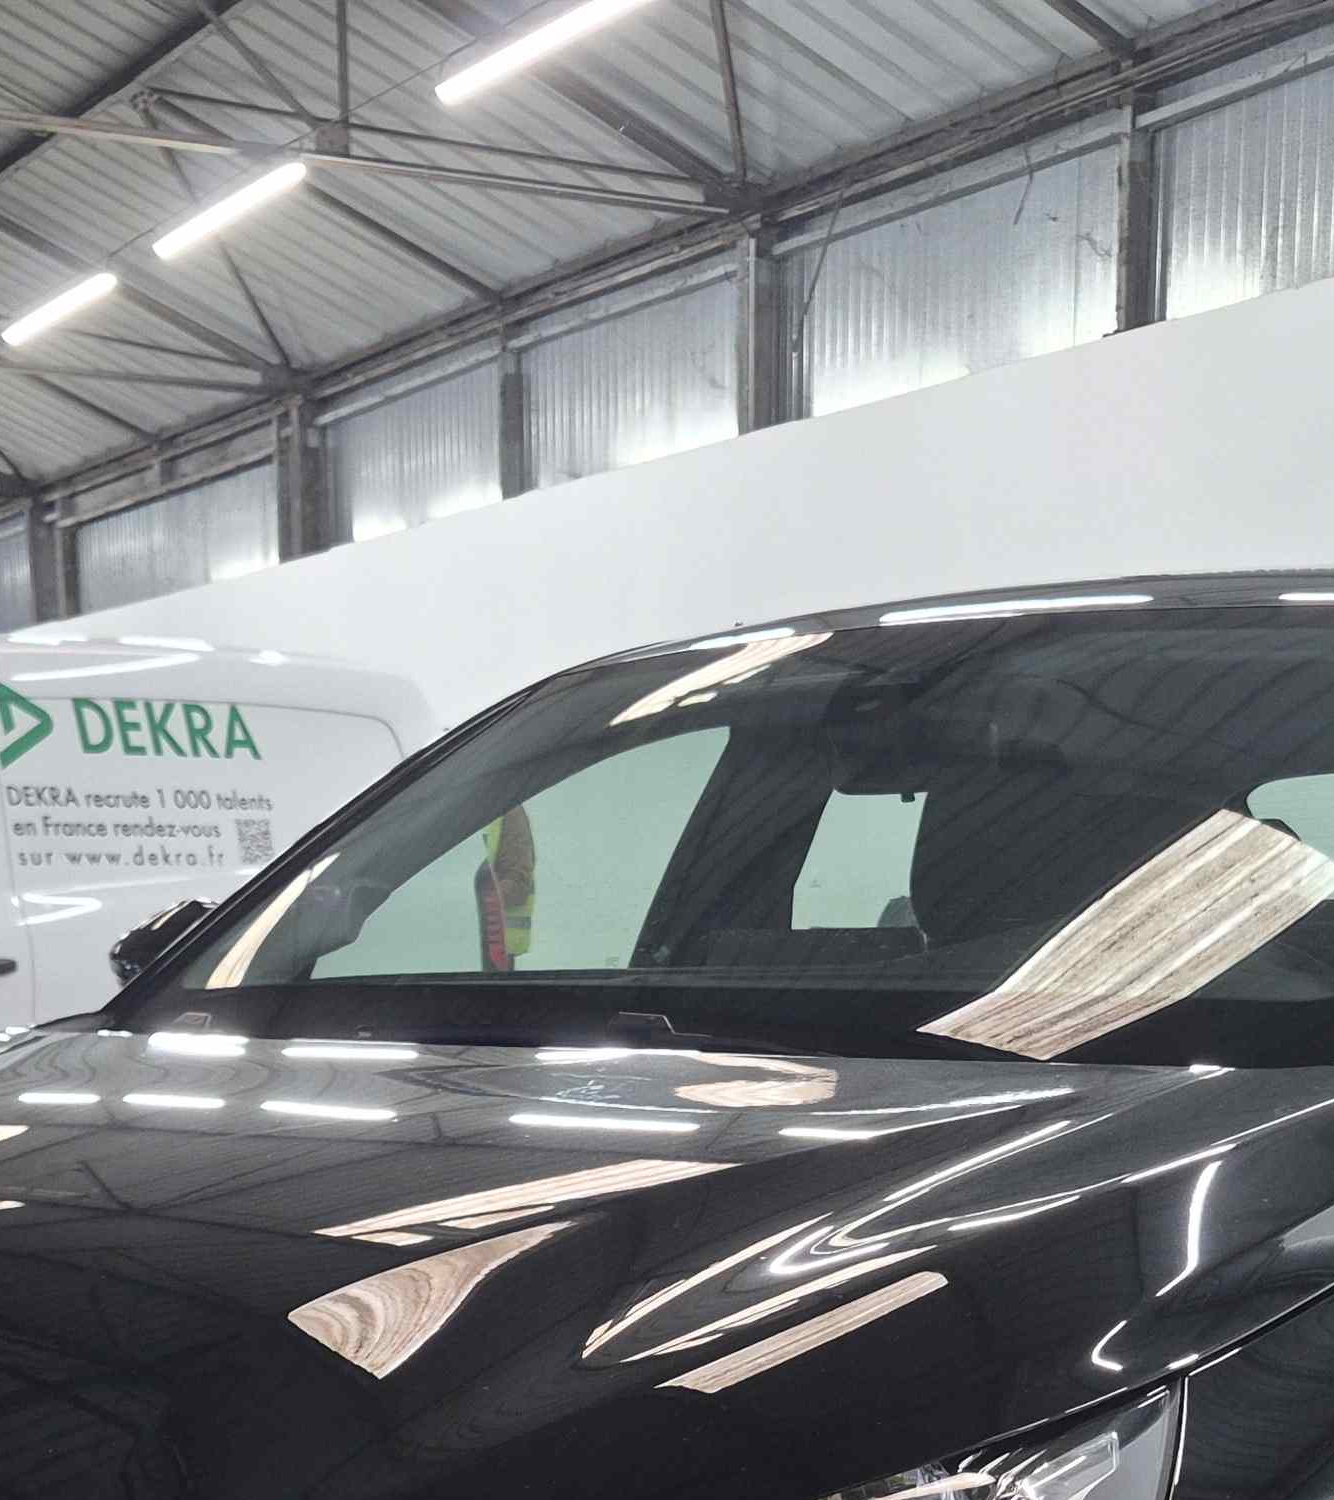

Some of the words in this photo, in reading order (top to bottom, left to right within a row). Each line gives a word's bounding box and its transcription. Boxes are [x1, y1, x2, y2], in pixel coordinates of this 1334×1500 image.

[72, 697, 262, 760] DEKRA
[6, 785, 80, 808] DEKRA
[84, 790, 150, 809] recrute
[156, 788, 166, 809] 1
[174, 789, 212, 810] 000
[216, 789, 273, 811] talents
[13, 822, 37, 837] en
[42, 815, 108, 837] France
[113, 816, 221, 838] rendez-vous
[18, 852, 53, 866] sur
[64, 844, 224, 867] www.dekra.fr
